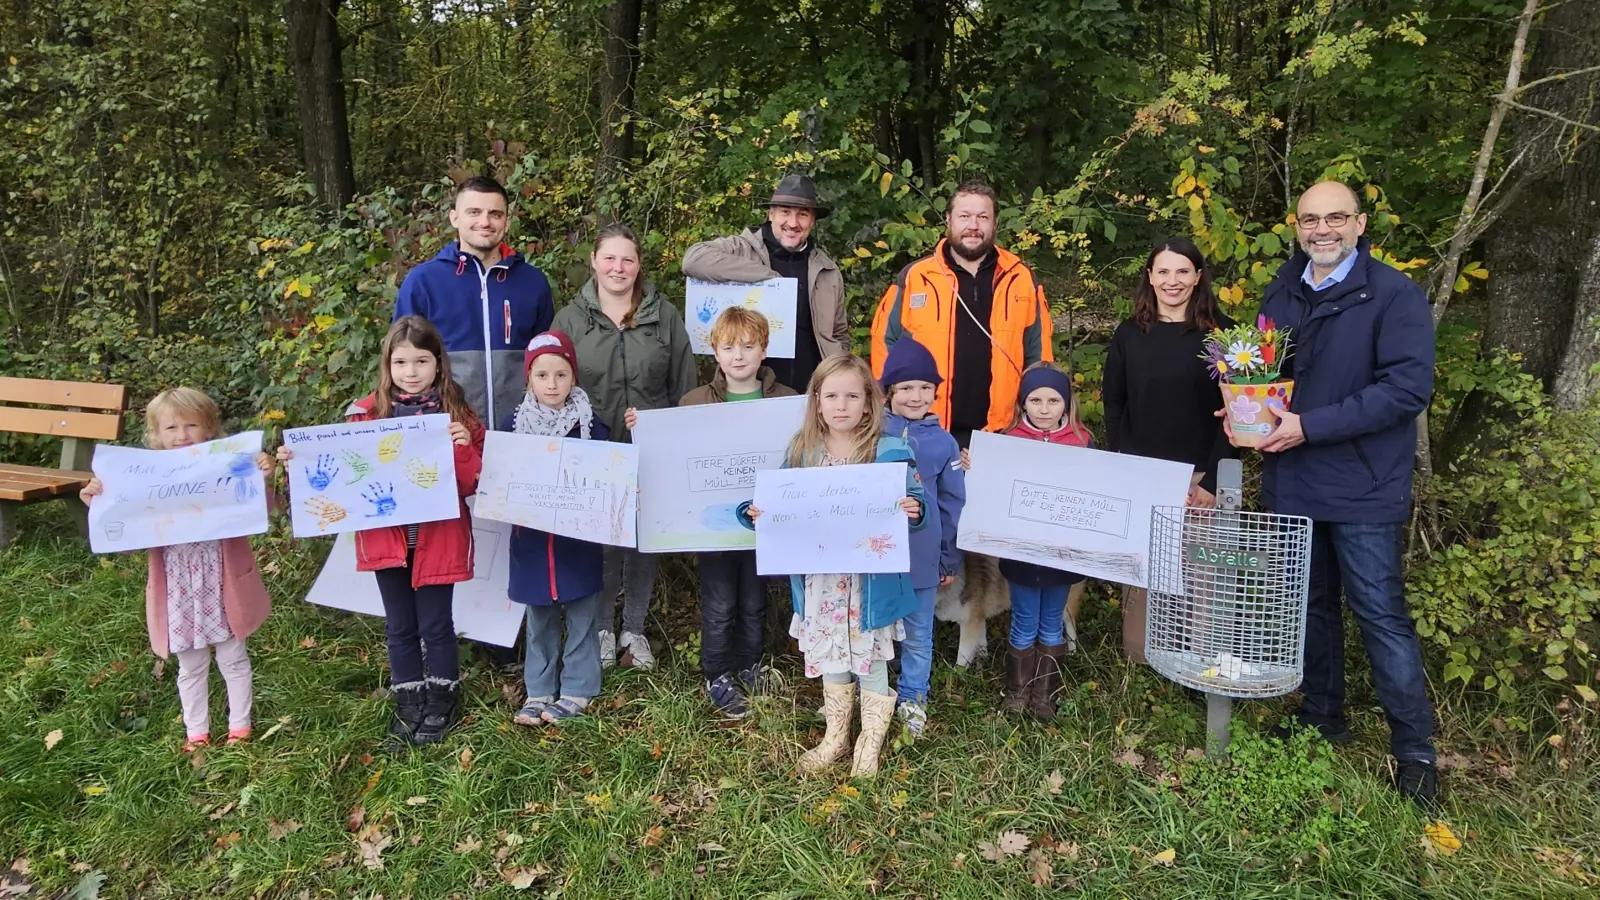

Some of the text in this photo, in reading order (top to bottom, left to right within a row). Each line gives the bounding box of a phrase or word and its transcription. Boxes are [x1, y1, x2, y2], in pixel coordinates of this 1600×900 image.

[288, 432, 313, 444] Bitte
[317, 428, 338, 441] passt
[379, 423, 404, 432] Umwelt
[407, 421, 420, 430] auf
[693, 455, 767, 470] TIERE DÜRFEN
[723, 466, 756, 476] KEINEN
[704, 475, 756, 488] MÜLL FRE
[147, 480, 208, 500] TONNE
[528, 493, 551, 501] NICHT
[1020, 499, 1105, 520] AUF DIE STRASSE
[1054, 493, 1086, 505] KEINEN
[1090, 499, 1117, 512] MÜLL
[807, 509, 821, 519] sie
[829, 504, 856, 516] Müll
[1049, 514, 1097, 527] WERFEN!
[1196, 546, 1259, 567] Abfälle
